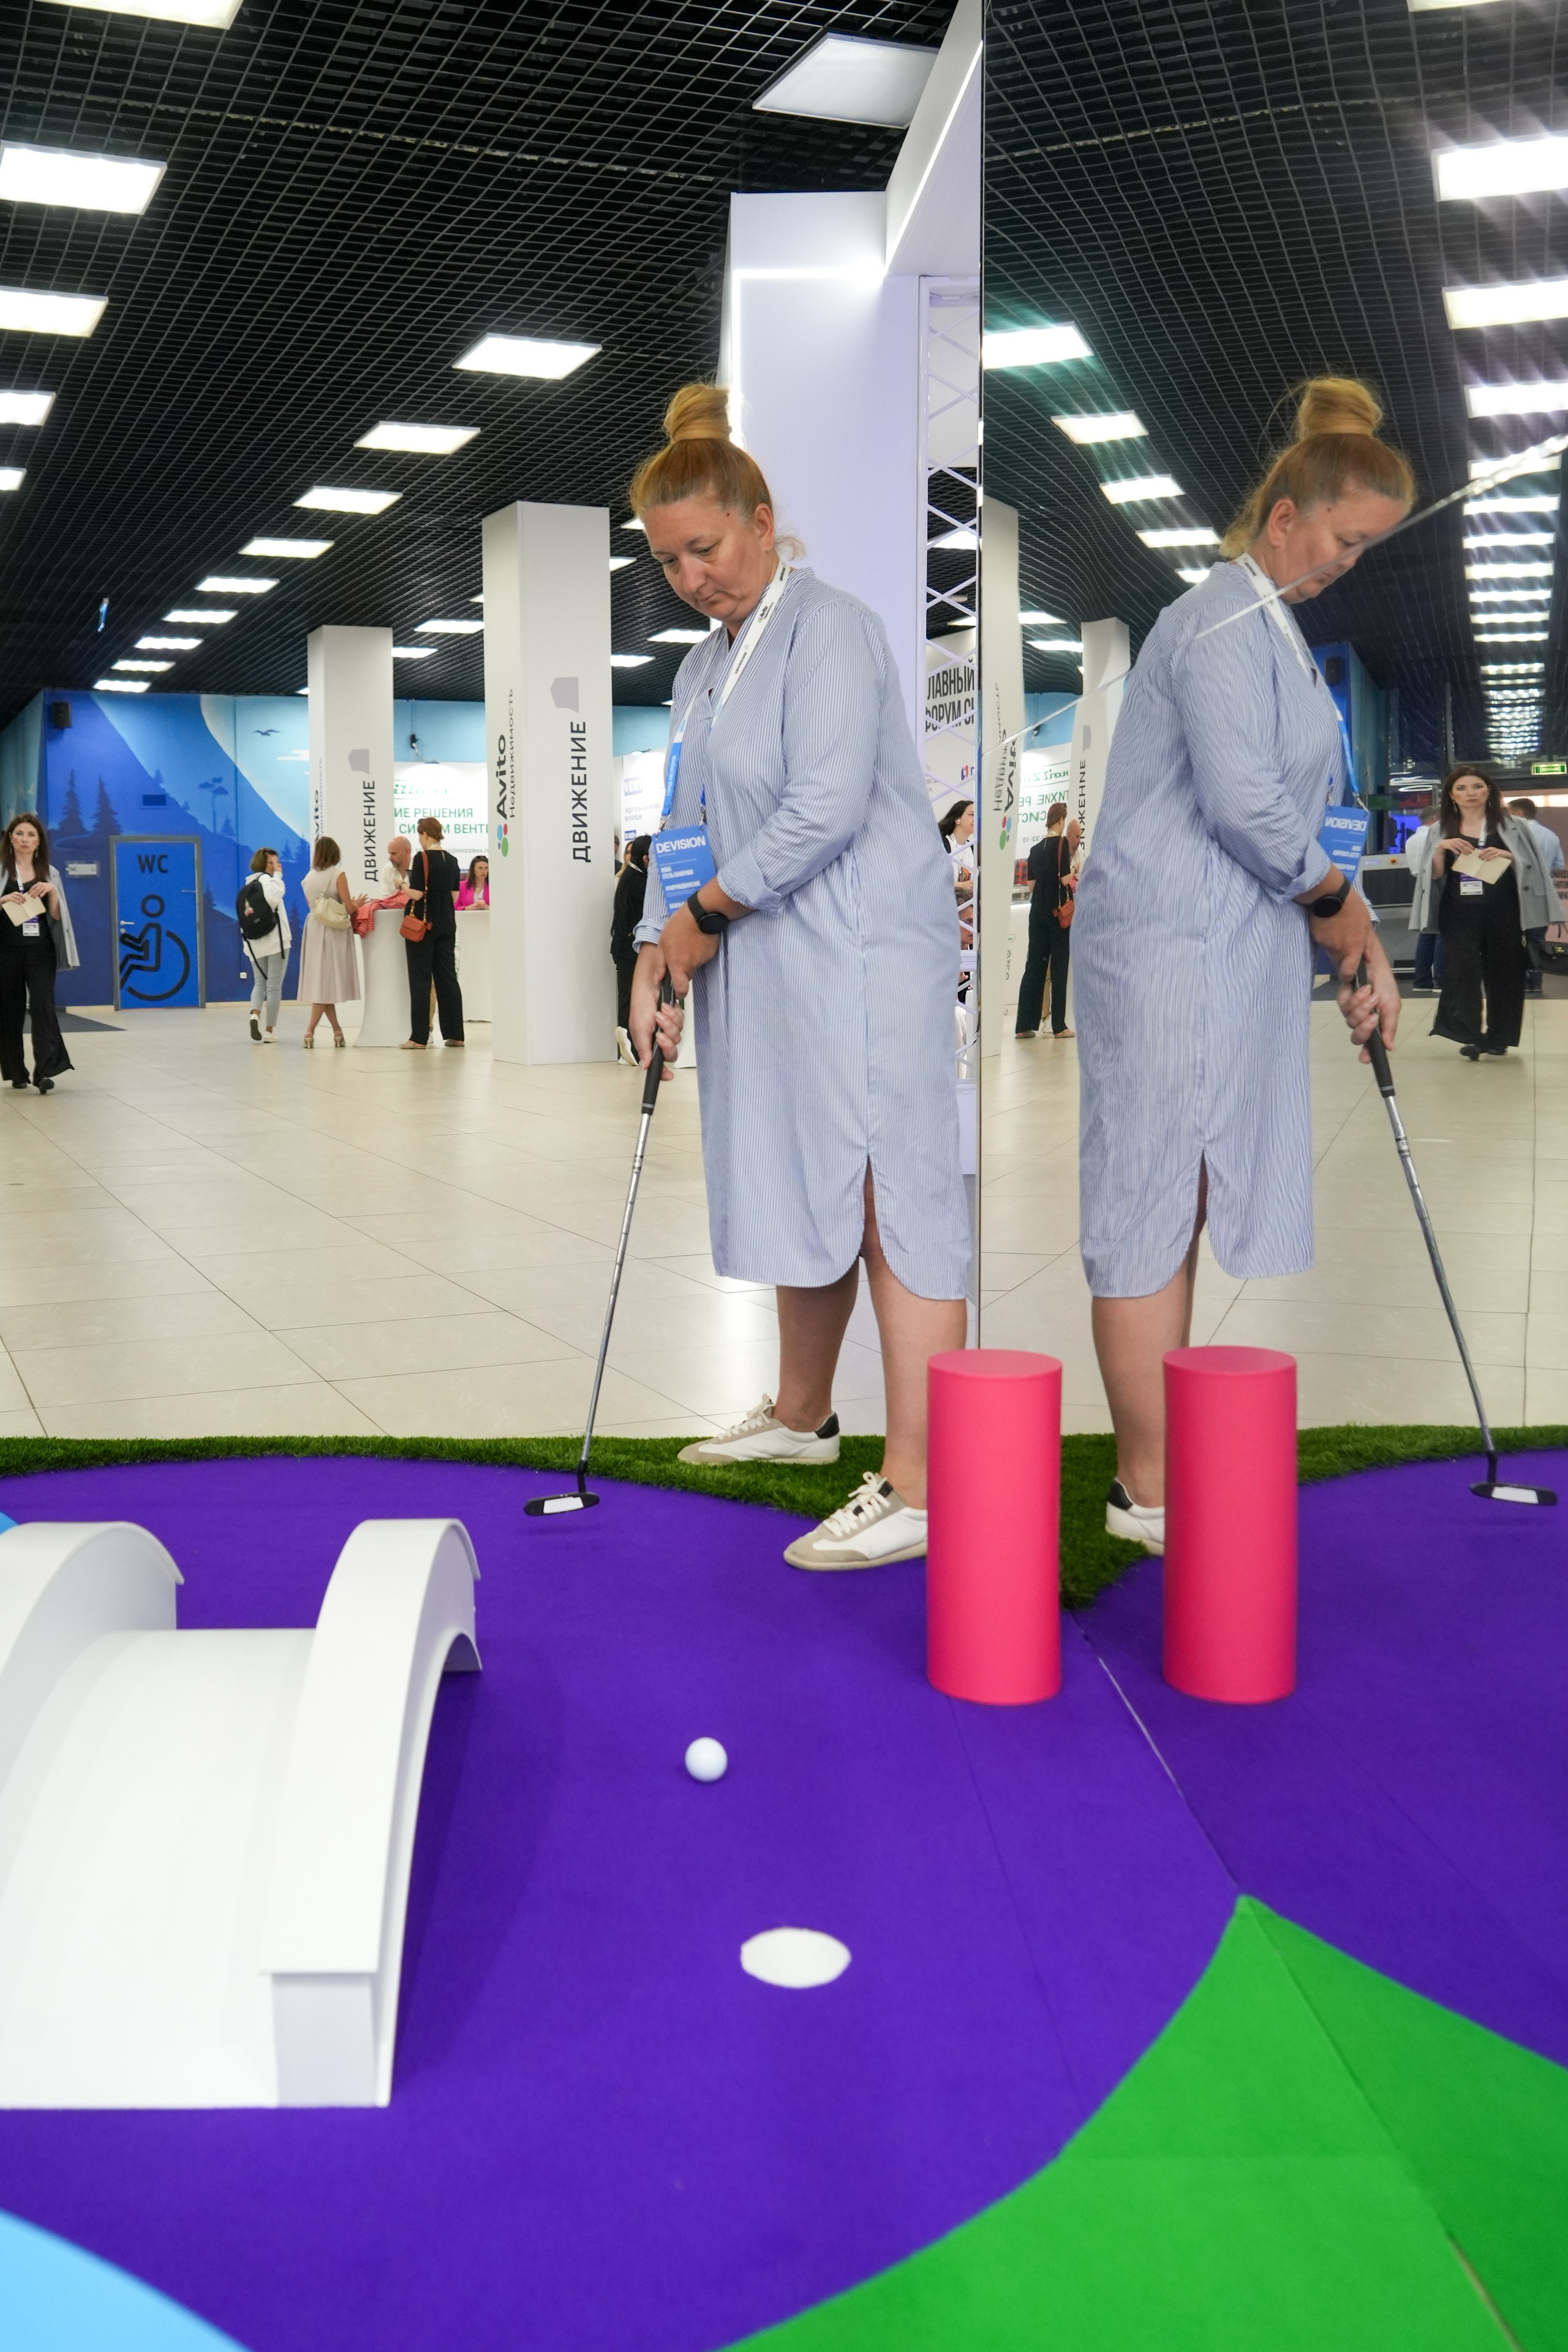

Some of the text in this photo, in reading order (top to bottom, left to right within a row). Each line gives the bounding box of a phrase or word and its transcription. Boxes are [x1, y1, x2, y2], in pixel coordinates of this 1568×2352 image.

[496, 734, 507, 820] Avito
[570, 722, 591, 863] ДВИЖЕНИЕ
[414, 808, 473, 818] РЕШЕНИЯ
[363, 781, 379, 882] ДВИЖЕНИЕ
[399, 824, 450, 834] СИМ
[655, 835, 706, 854] DEVISION
[137, 854, 168, 873] WC
